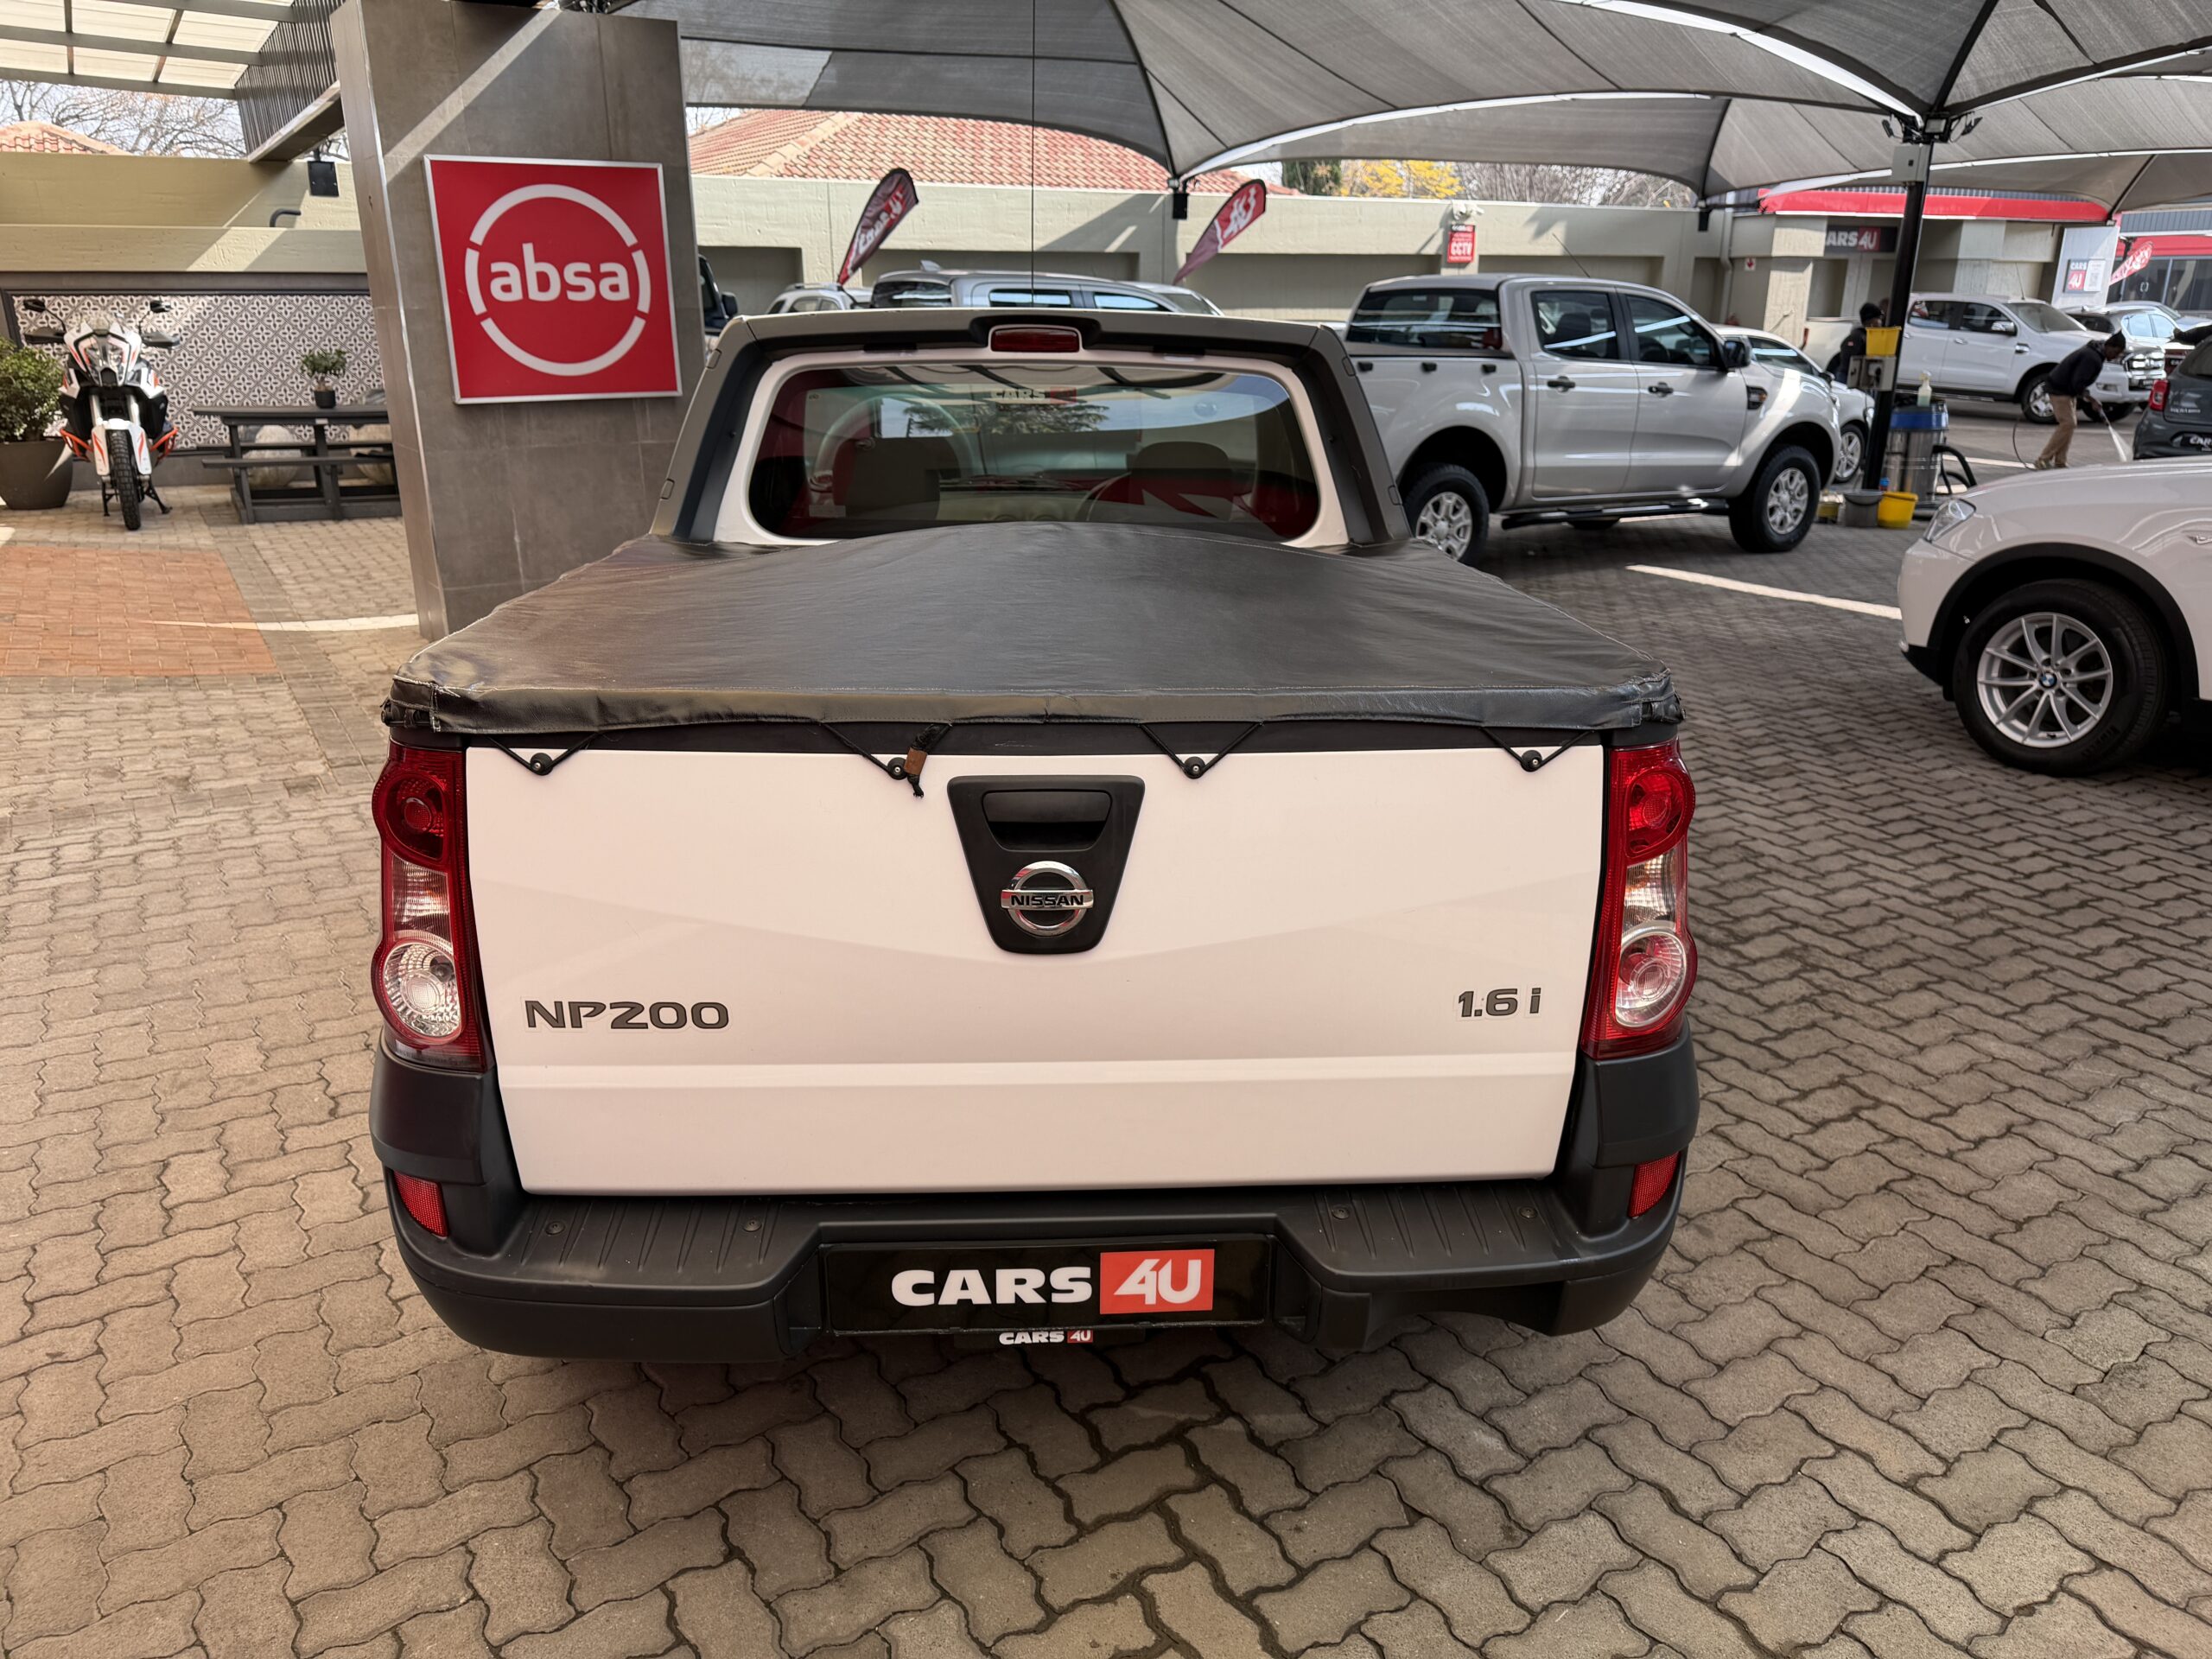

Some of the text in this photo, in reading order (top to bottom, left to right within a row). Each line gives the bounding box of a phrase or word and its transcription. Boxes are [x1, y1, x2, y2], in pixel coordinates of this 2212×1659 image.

[1825, 231, 1878, 250] ARS 4U
[490, 243, 630, 302] absa
[991, 389, 1046, 400] CARS
[2190, 434, 2212, 447] CAR
[1011, 895, 1084, 906] NISSAN
[525, 1001, 729, 1029] NP200
[892, 1258, 1202, 1306] CARS 4U
[999, 1330, 1091, 1345] CARS 4U
